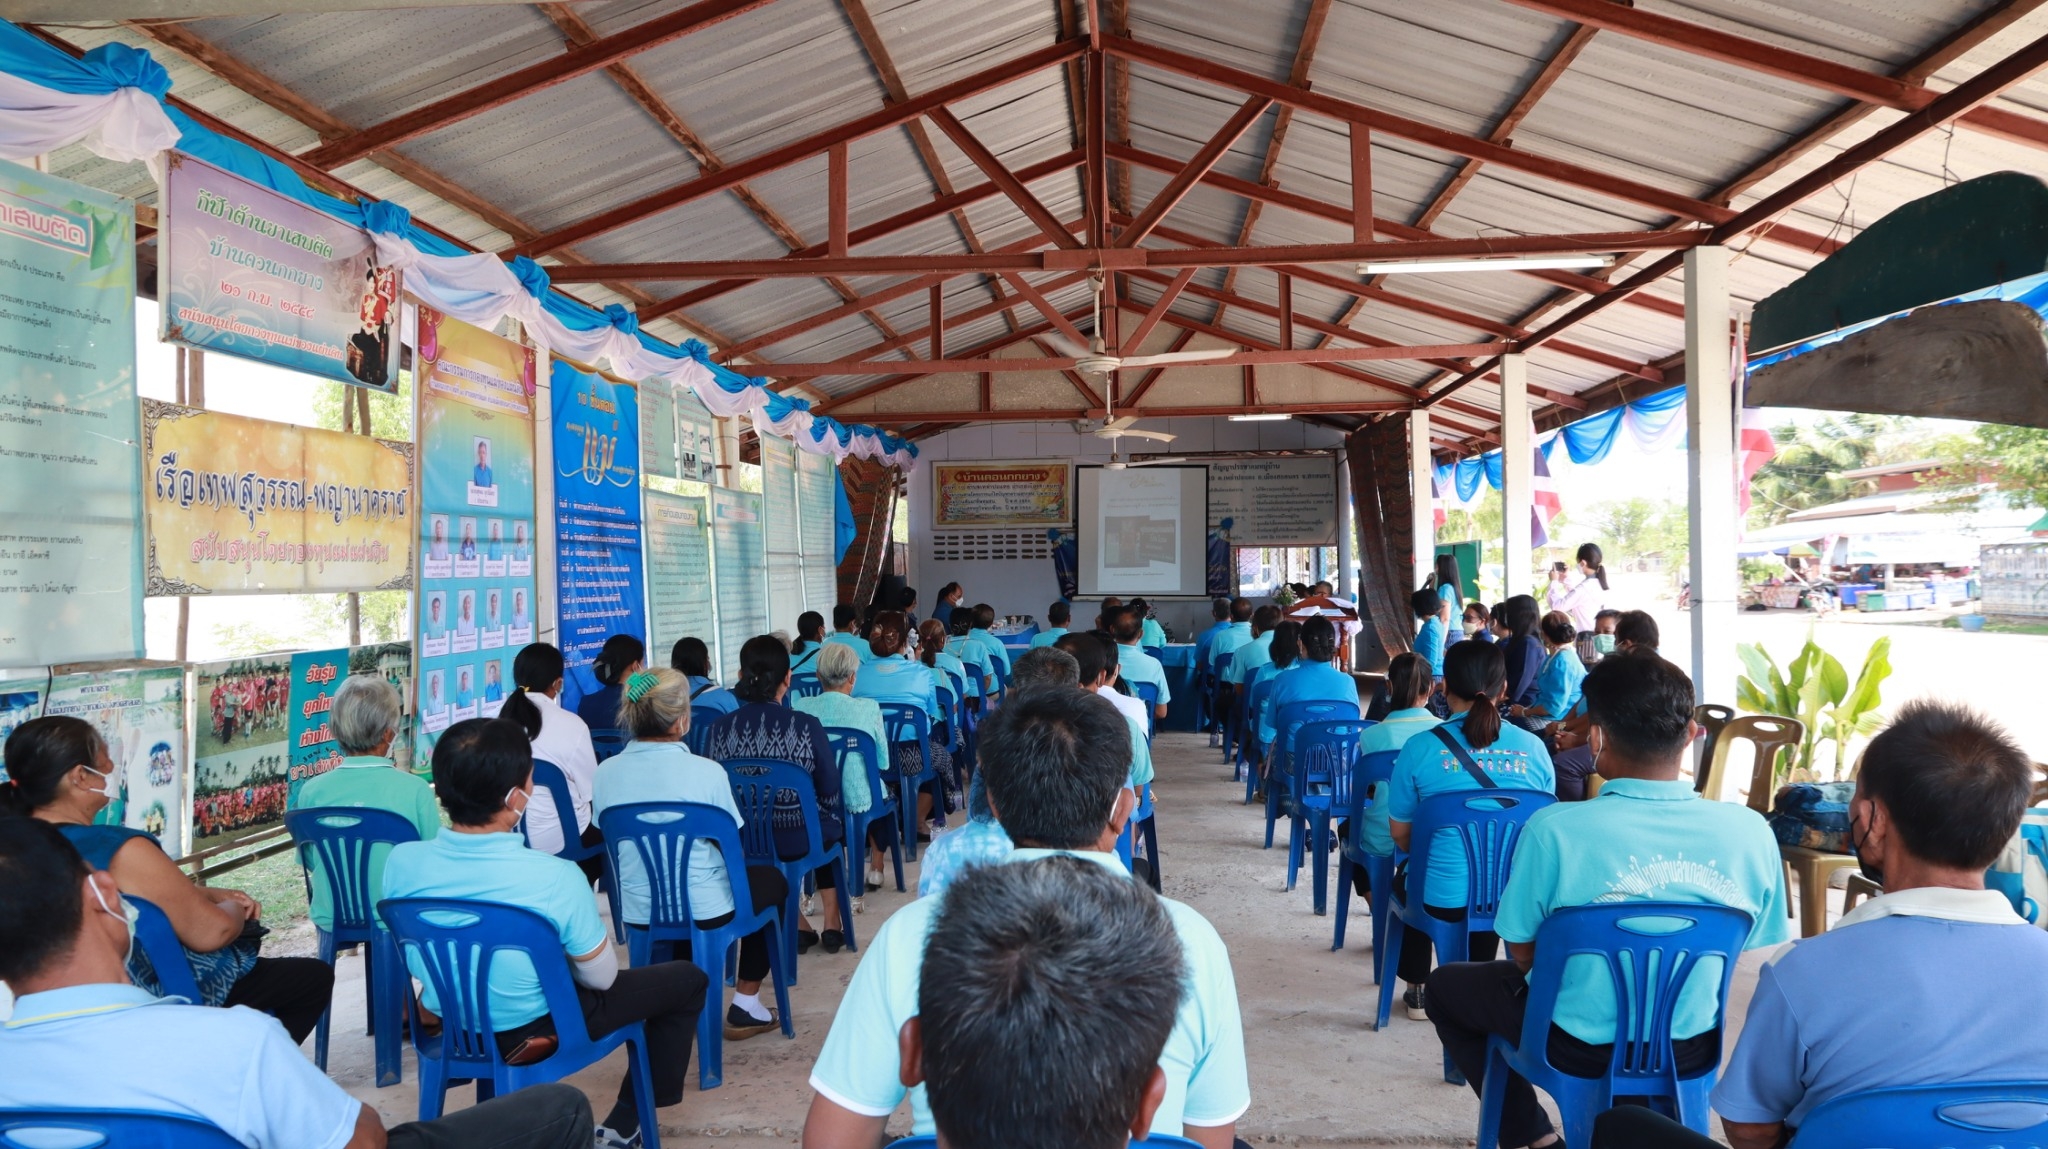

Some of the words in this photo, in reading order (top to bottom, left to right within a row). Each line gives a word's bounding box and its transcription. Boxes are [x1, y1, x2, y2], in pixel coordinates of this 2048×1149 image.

[196, 189, 334, 259] กีฬาต้านยาเสพติด
[306, 662, 338, 684] วัยรุ่น
[303, 692, 334, 719] ยุคให
[299, 723, 335, 747] ห่างไก
